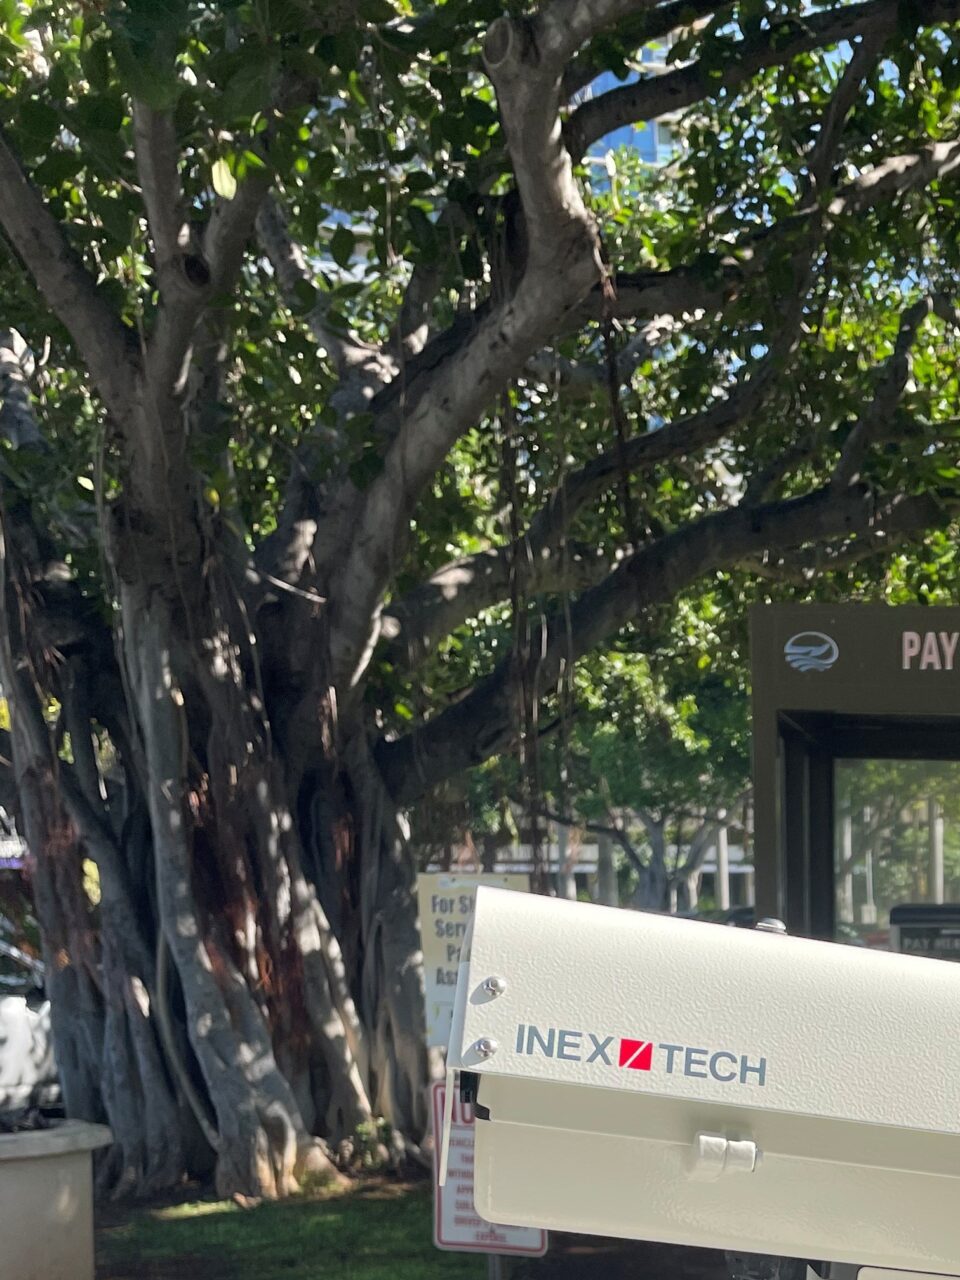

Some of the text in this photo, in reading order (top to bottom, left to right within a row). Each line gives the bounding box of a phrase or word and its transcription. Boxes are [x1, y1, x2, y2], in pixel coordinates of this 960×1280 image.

[901, 630, 960, 670] PAY
[432, 894, 455, 914] For
[515, 1023, 767, 1087] INEX TECH
